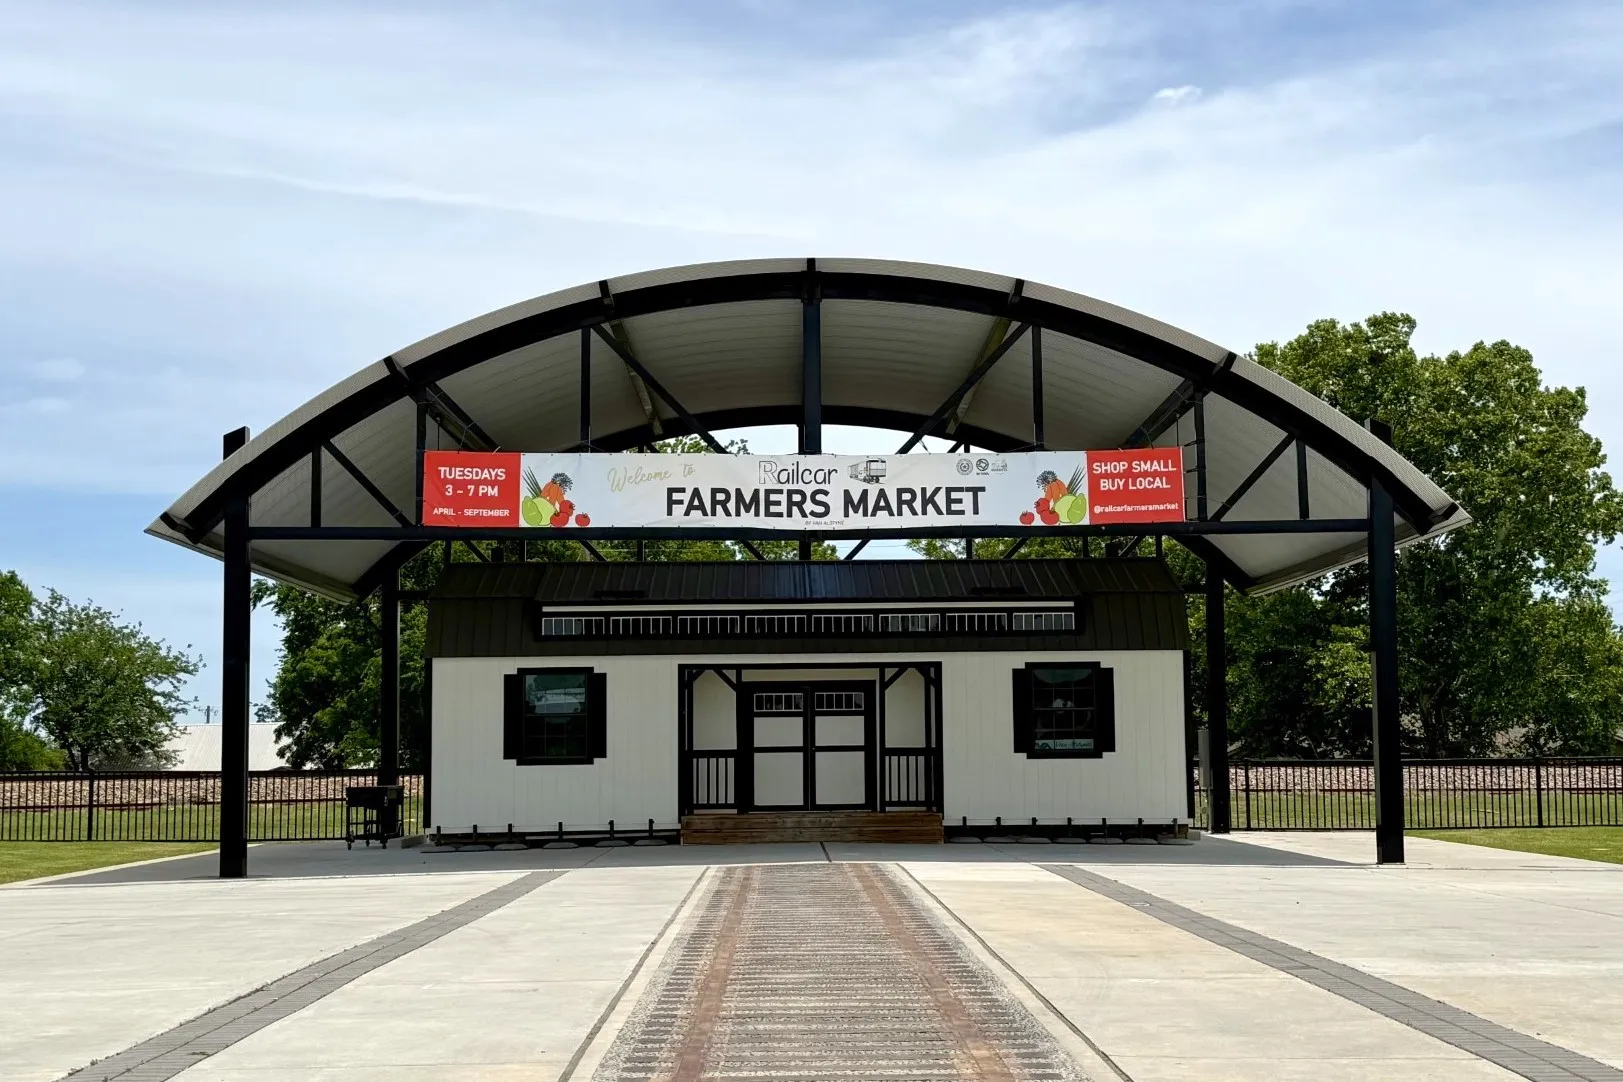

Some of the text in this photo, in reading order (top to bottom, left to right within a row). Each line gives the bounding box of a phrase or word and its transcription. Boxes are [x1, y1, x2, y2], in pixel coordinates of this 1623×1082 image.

[438, 466, 506, 481] TUESDAYS
[758, 460, 838, 485] Railcar
[1092, 459, 1177, 474] SHOP SMALL
[607, 463, 696, 492] Welcome to
[1100, 476, 1171, 491] BUY LOCAL
[445, 484, 453, 496] 3
[467, 484, 475, 497] 7
[478, 485, 499, 497] PM
[666, 485, 986, 519] FARMERS MARKET
[1093, 502, 1179, 514] @railcarfarmersmarket
[433, 507, 456, 516] APRIL
[463, 508, 510, 517] SEPTEMBER
